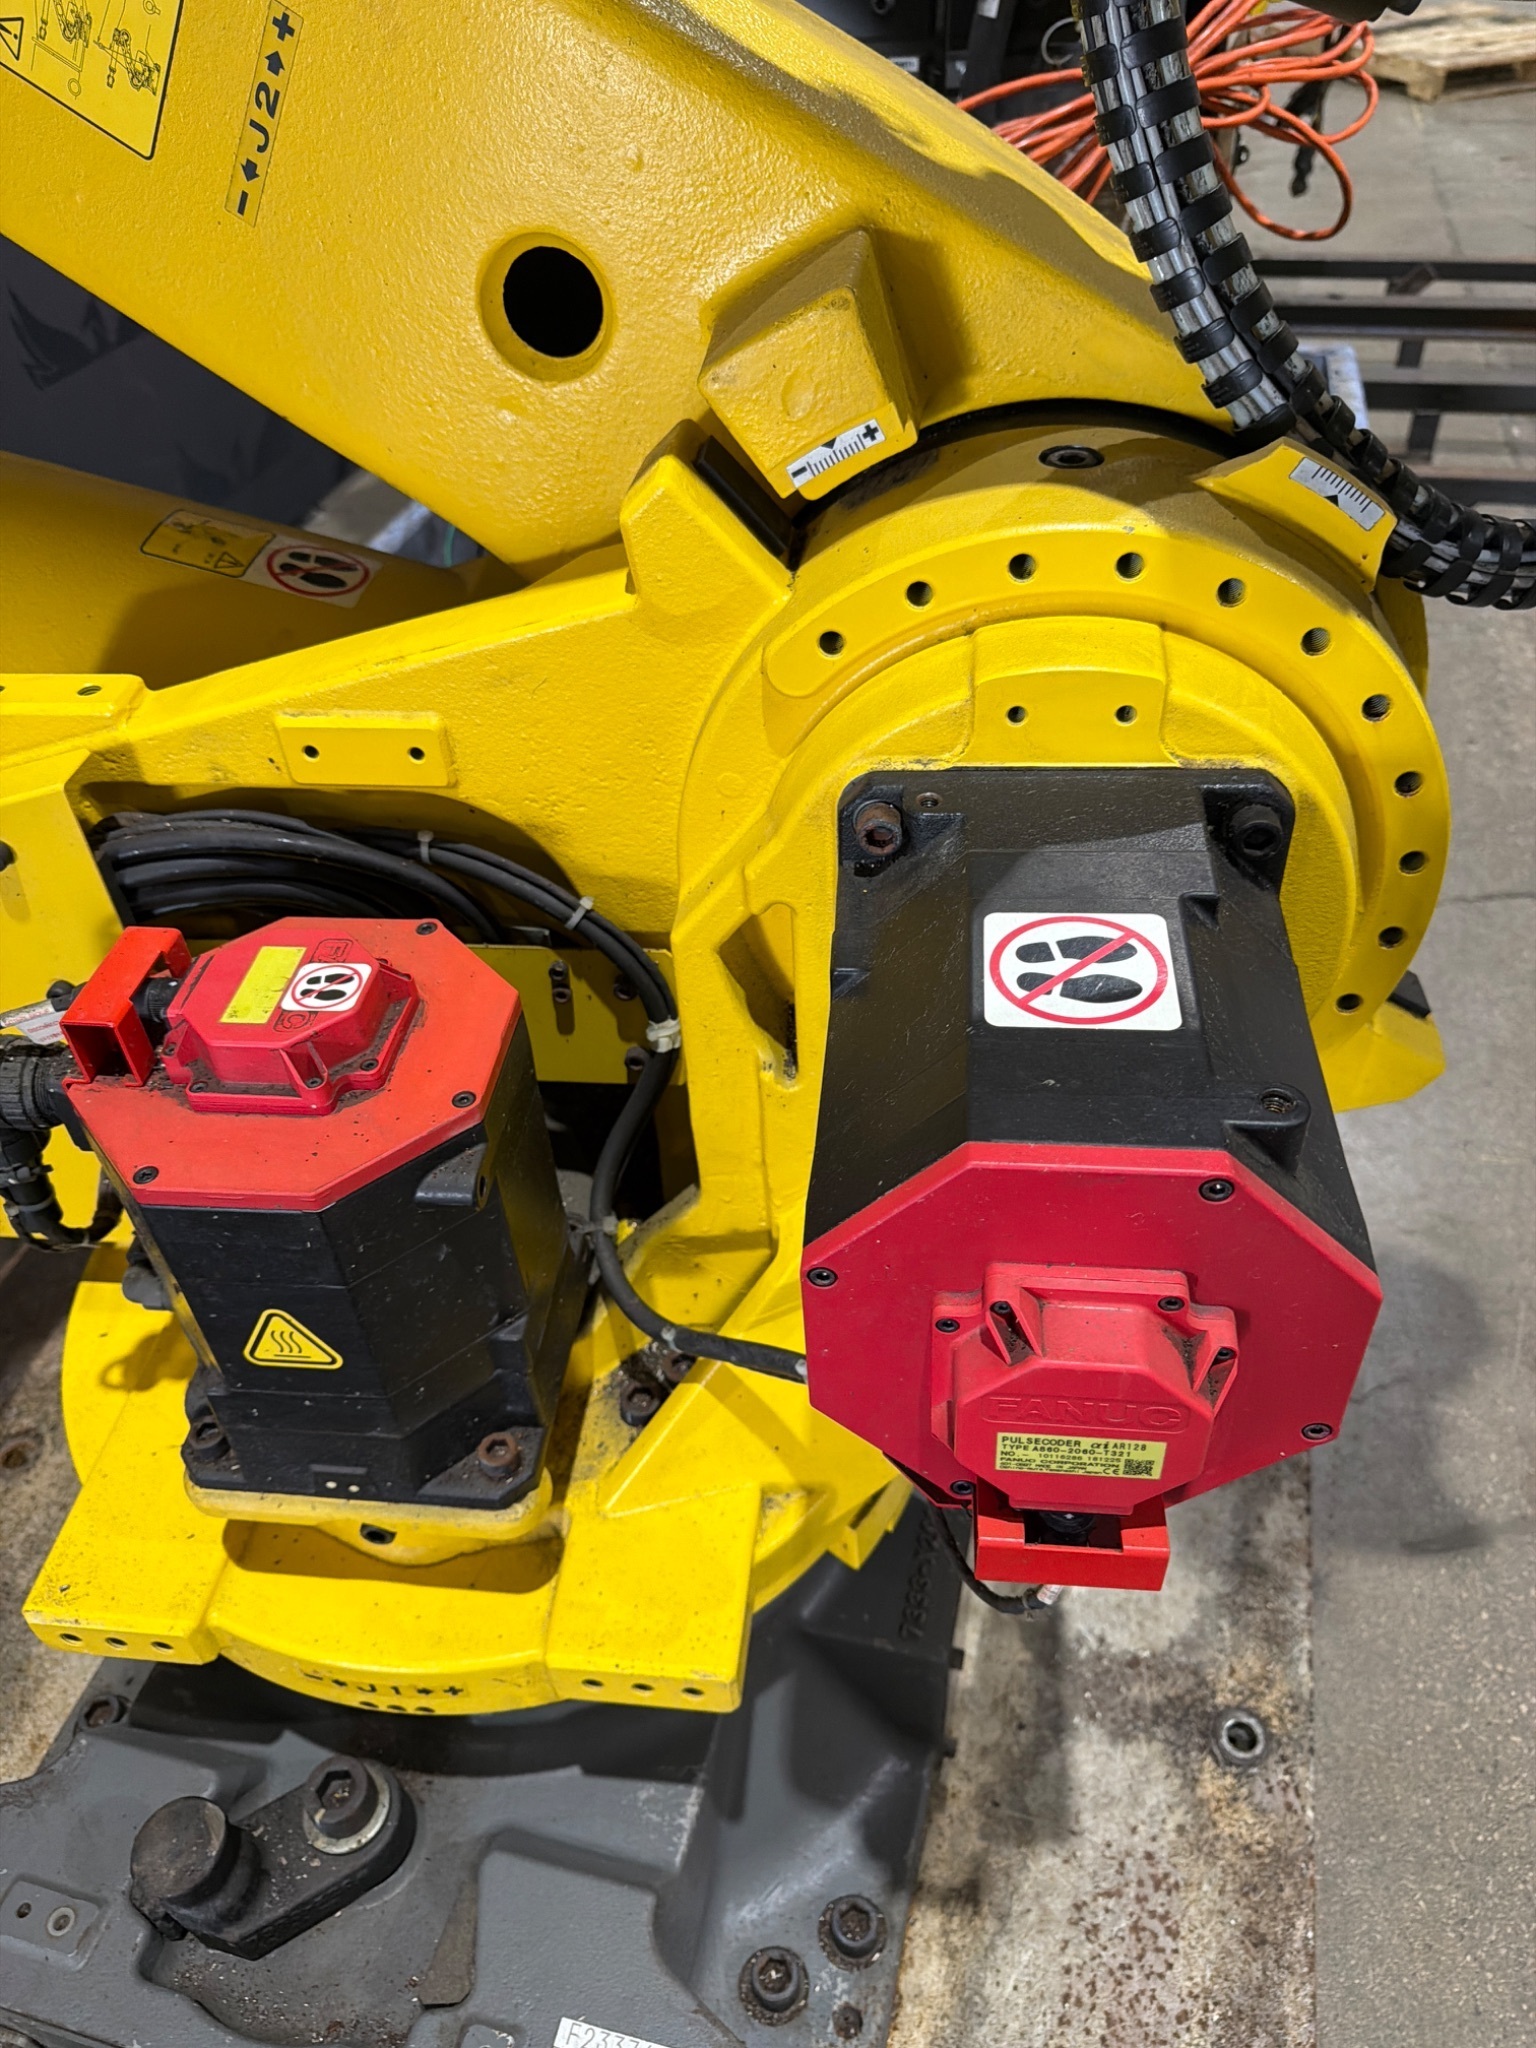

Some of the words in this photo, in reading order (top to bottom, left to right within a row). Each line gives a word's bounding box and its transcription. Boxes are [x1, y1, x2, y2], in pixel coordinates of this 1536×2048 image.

[248, 81, 281, 154] J2
[989, 1396, 1182, 1425] FANUC
[1001, 1436, 1082, 1447] PULSECODER
[1039, 1460, 1120, 1468] CORPORATION
